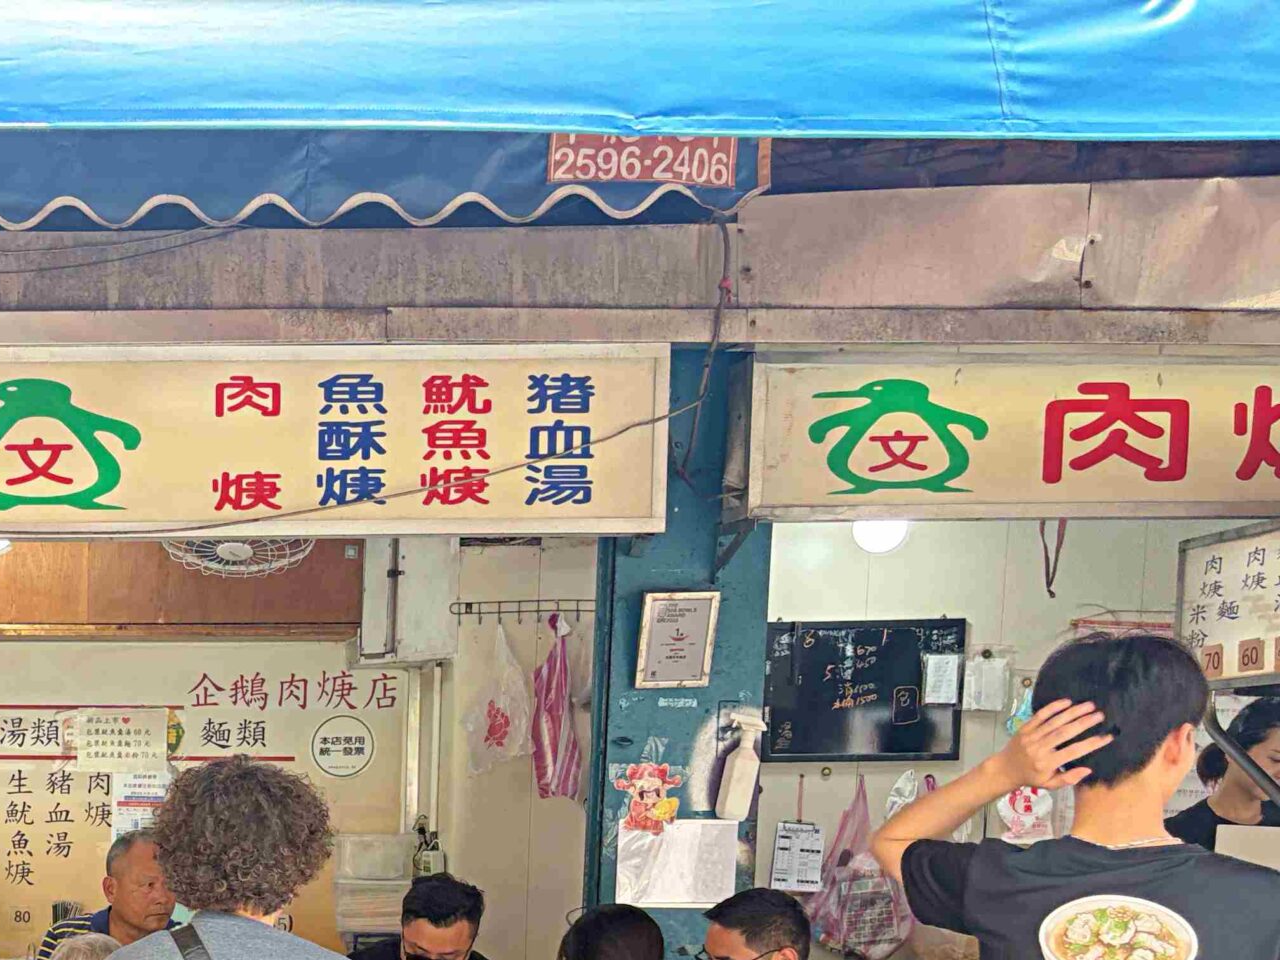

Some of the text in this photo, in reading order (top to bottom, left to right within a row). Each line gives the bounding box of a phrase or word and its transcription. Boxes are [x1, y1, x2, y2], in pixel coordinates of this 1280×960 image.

[5, 438, 73, 486] 文
[868, 430, 929, 472] 文
[1204, 651, 1220, 671] 70
[1241, 646, 1259, 667] 60
[200, 717, 267, 749] 麵類
[319, 736, 365, 746] 本店免用
[45, 771, 75, 858] 豬血湯
[14, 910, 31, 923] 80
